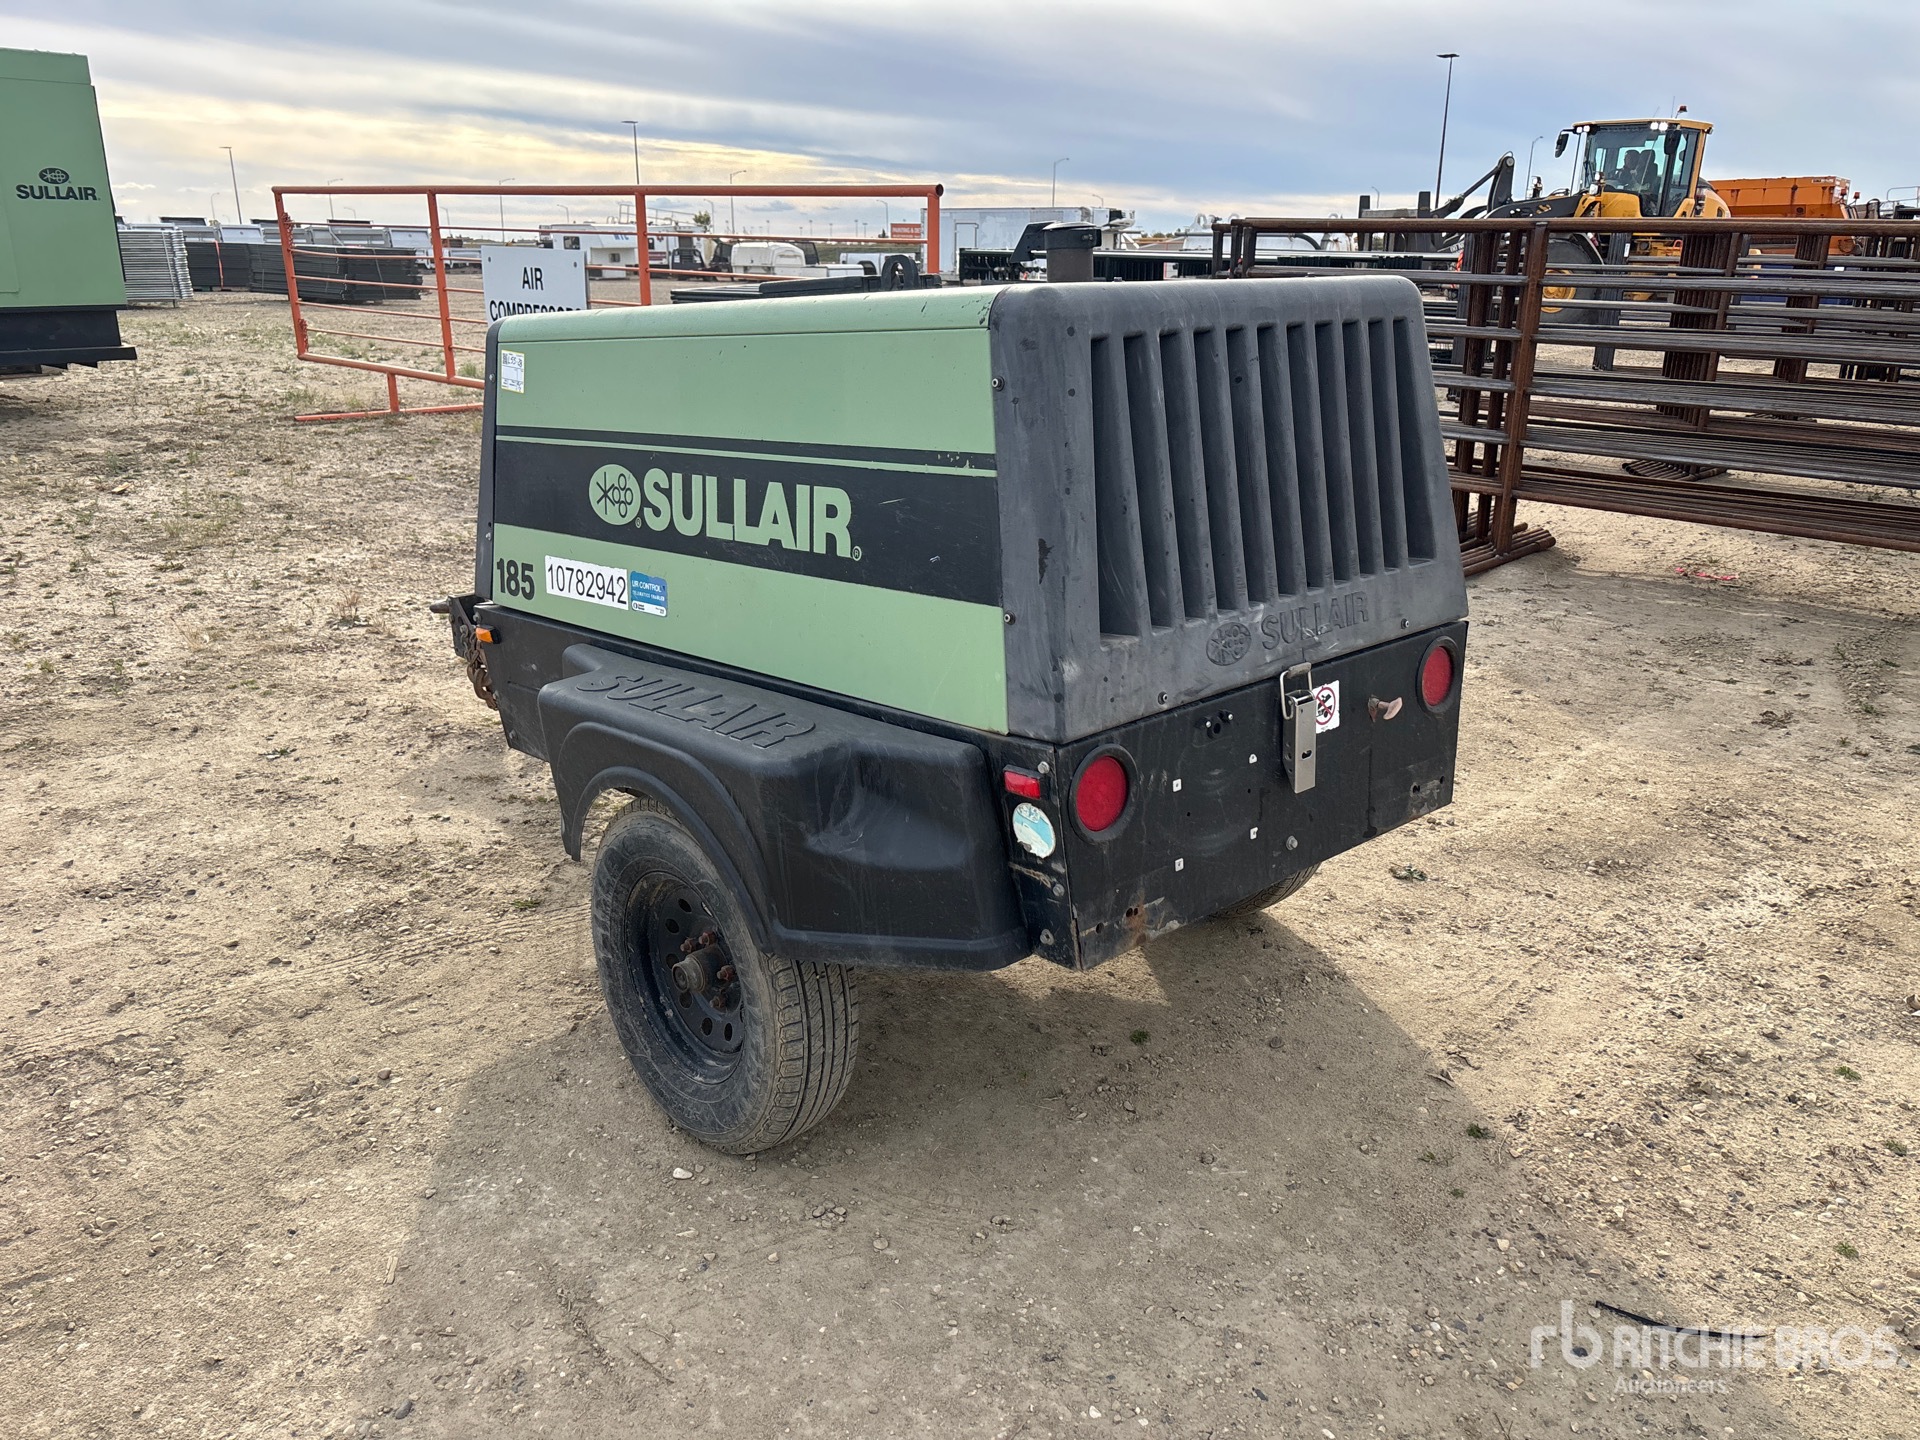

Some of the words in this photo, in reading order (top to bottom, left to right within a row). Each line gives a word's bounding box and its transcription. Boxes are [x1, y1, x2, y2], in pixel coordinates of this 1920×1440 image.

[15, 184, 98, 200] SULLAIR
[522, 267, 544, 291] AIR
[497, 558, 535, 600] 185
[548, 564, 627, 605] 10782942
[1261, 590, 1369, 650] SULLAIR
[576, 675, 816, 749] SULLAIR
